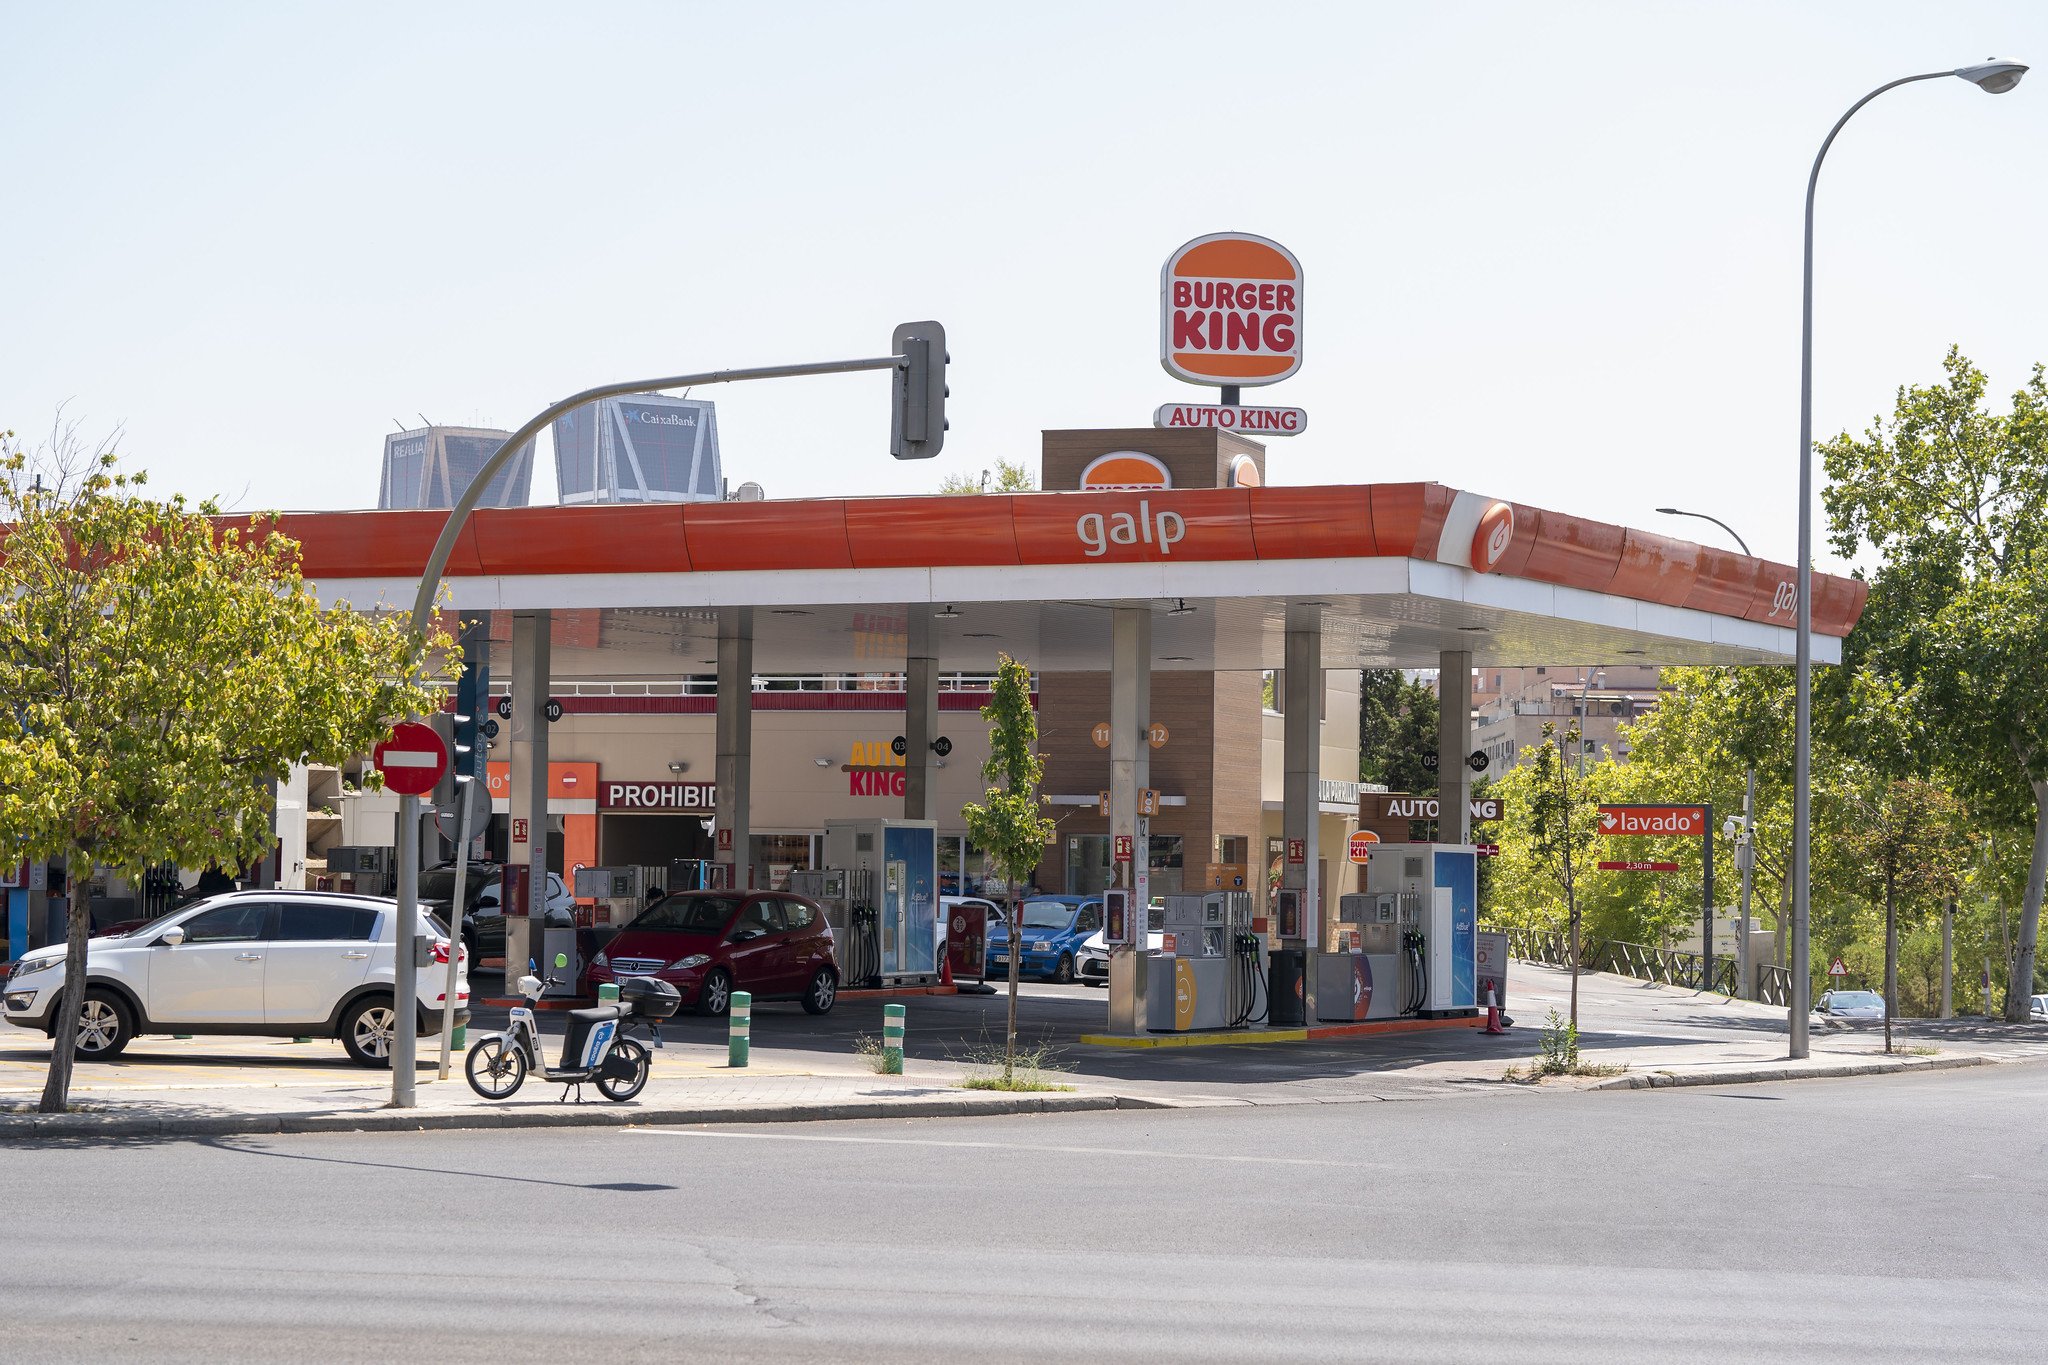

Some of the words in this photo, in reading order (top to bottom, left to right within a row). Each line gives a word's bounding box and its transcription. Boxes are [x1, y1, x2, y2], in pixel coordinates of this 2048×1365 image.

[1173, 280, 1296, 312] BURGER
[1173, 309, 1296, 353] KING
[641, 411, 697, 427] CaixaBank
[1169, 407, 1236, 428] AUTO
[1240, 410, 1298, 431] KING
[1076, 500, 1187, 557] galp
[547, 705, 560, 716] 10
[486, 725, 496, 734] 02
[1096, 729, 1110, 742] 11
[1150, 729, 1166, 742] 12
[894, 741, 906, 751] 03
[937, 742, 949, 751] 04
[850, 741, 906, 767] AUT
[1424, 755, 1438, 767] 05
[1472, 757, 1486, 767] 06
[1387, 799, 1440, 818] AUTO
[1469, 801, 1497, 819] NG
[1621, 812, 1691, 831] lavado
[1350, 847, 1368, 857] KIN
[1626, 862, 1643, 870] 2,30
[1643, 862, 1652, 870] m
